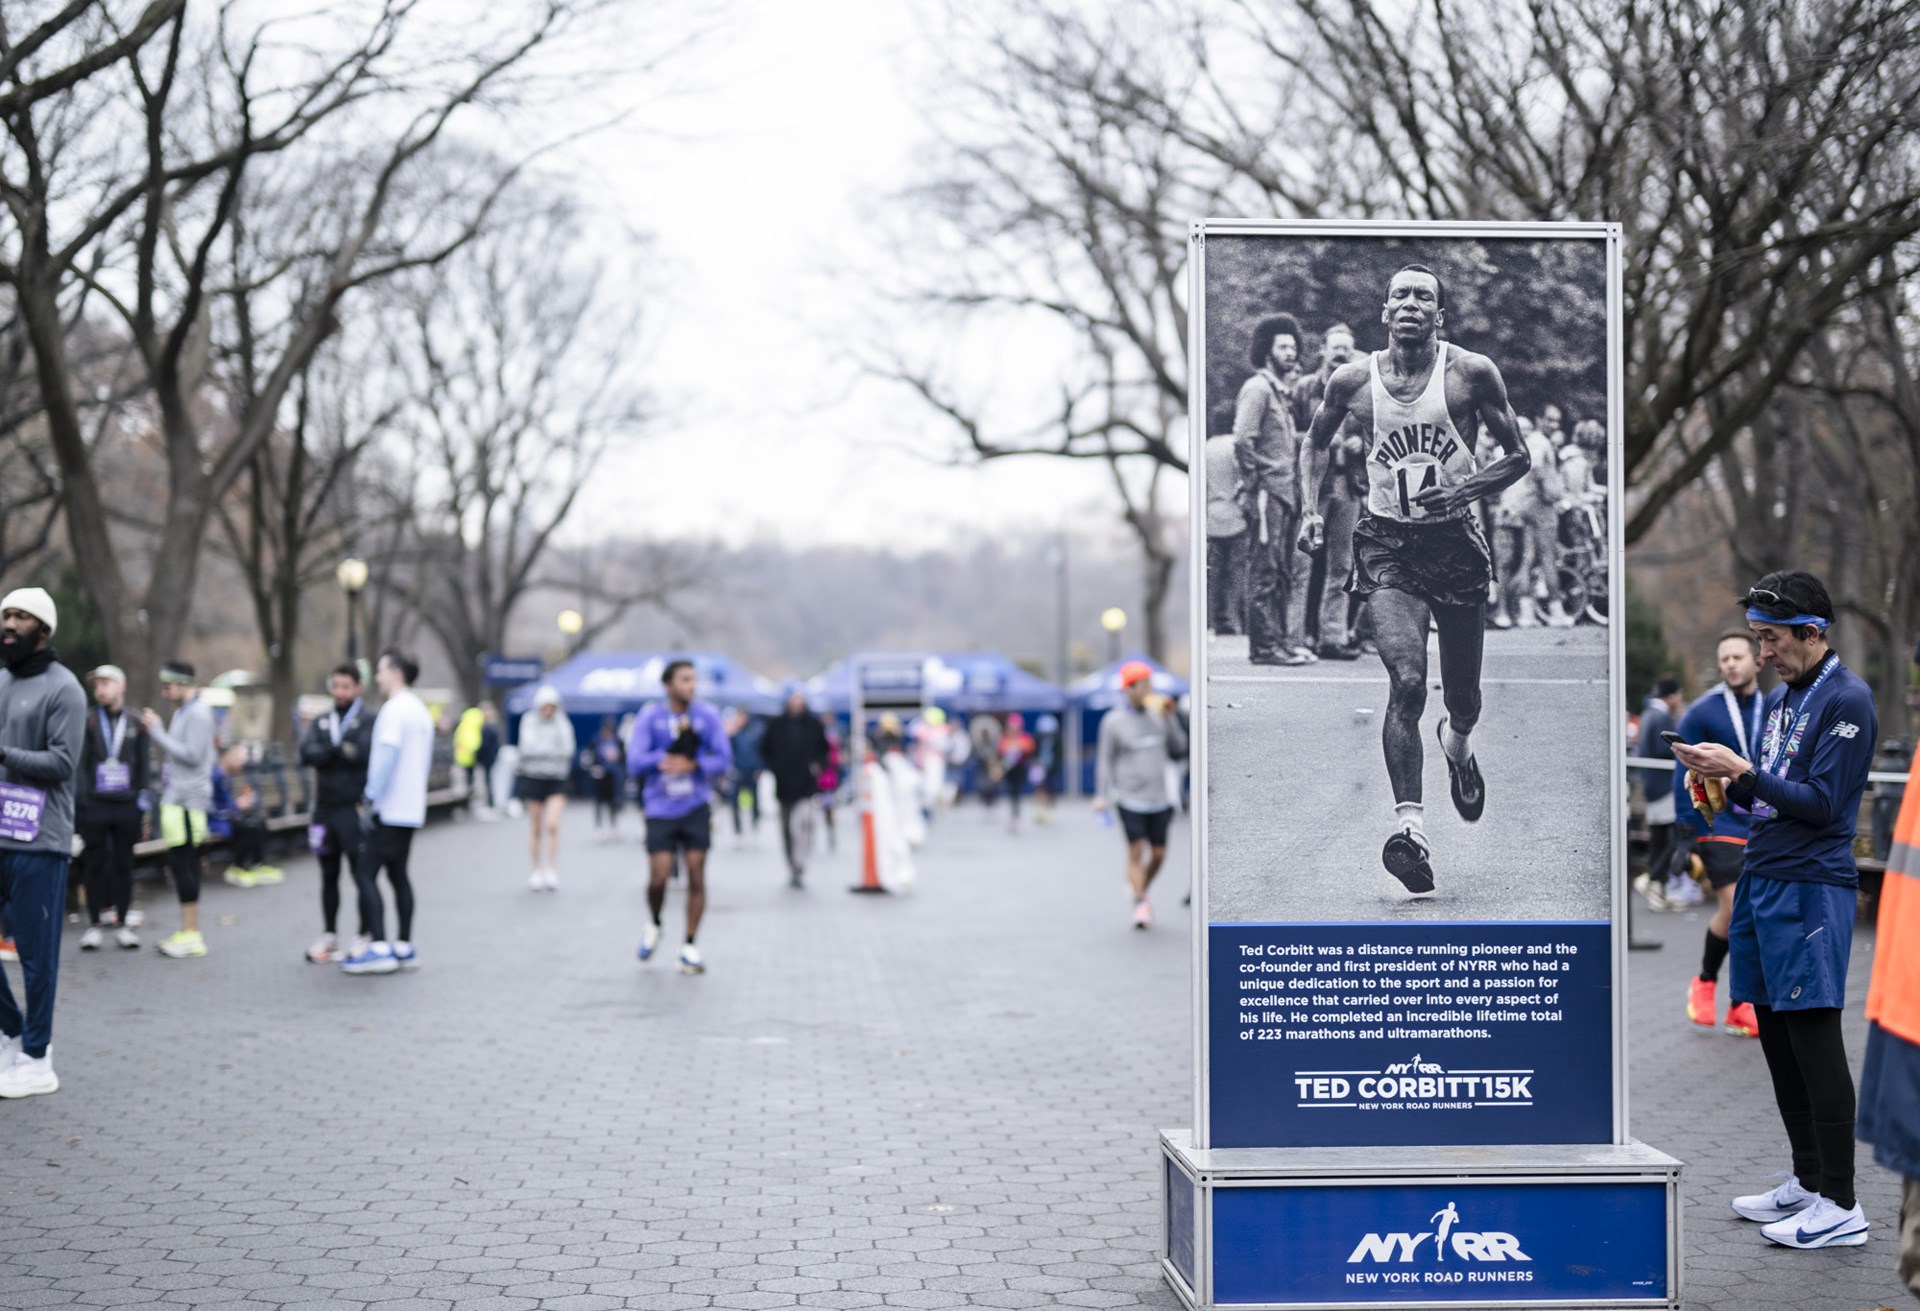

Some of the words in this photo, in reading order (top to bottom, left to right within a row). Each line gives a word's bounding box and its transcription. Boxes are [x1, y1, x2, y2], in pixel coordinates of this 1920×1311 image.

[1375, 423, 1459, 470] PIONEER
[1238, 944, 1264, 957] Ted
[1266, 943, 1315, 956] Corbitt
[1316, 946, 1343, 956] was
[1345, 945, 1355, 956] a
[1357, 943, 1414, 956] distance
[1416, 942, 1468, 957] running
[1471, 942, 1524, 957] pioneer
[1526, 942, 1552, 955] and
[1555, 942, 1578, 955] the
[1239, 960, 1313, 973] co-founder
[1315, 960, 1341, 973] and
[1343, 960, 1371, 972] first
[1374, 959, 1438, 974] president
[1440, 959, 1456, 972] of
[1458, 959, 1498, 972] NYRR
[1500, 959, 1530, 972] who
[1532, 959, 1558, 972] had
[1561, 961, 1570, 972] a
[1239, 977, 1285, 992] unique
[1287, 977, 1359, 990] dedication
[1361, 977, 1377, 989] to
[1379, 976, 1402, 989] the
[1405, 977, 1441, 991] sport
[1443, 976, 1469, 989] and
[1472, 978, 1481, 989] a
[1484, 976, 1535, 991] passion
[1538, 976, 1559, 988] for
[1239, 994, 1309, 1007] excellence
[1311, 993, 1340, 1006] that
[1342, 993, 1390, 1006] carried
[1392, 995, 1423, 1006] over
[1425, 993, 1453, 1005] into
[1455, 995, 1493, 1007] every
[1495, 993, 1541, 1007] aspect
[1544, 992, 1559, 1005] of
[1239, 1011, 1259, 1024] his
[1262, 1011, 1287, 1024] life.
[1290, 1011, 1309, 1023] He
[1311, 1010, 1384, 1025] completed
[1386, 1012, 1403, 1022] an
[1406, 1009, 1473, 1022] incredible
[1476, 1009, 1528, 1022] lifetime
[1530, 1009, 1563, 1022] total
[1239, 1028, 1255, 1041] of
[1257, 1028, 1282, 1041] 223
[1285, 1027, 1356, 1040] marathons
[1358, 1027, 1384, 1040] and
[1387, 1026, 1492, 1039] ultramarathons.
[1294, 1078, 1351, 1099] TED
[1406, 1102, 1431, 1110] ROAD
[1345, 1273, 1378, 1284] NEW
[1382, 1273, 1420, 1283] YORK
[1424, 1272, 1464, 1282] ROAD
[1468, 1271, 1534, 1282] RUNNERS
